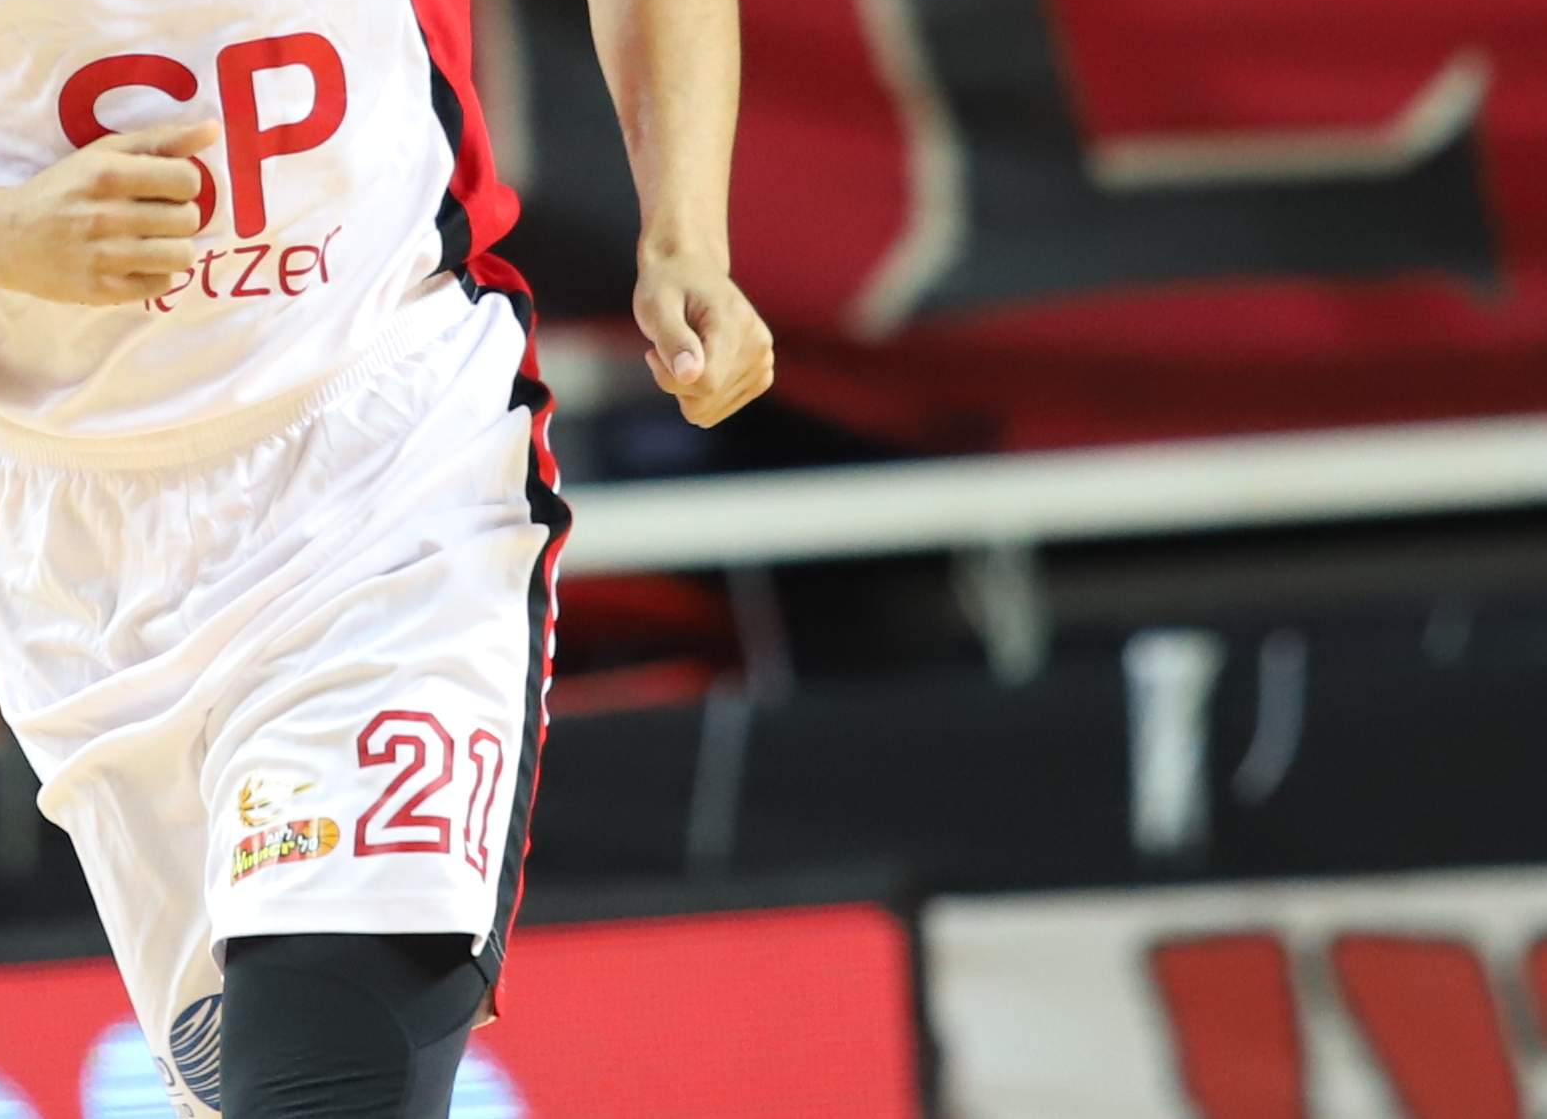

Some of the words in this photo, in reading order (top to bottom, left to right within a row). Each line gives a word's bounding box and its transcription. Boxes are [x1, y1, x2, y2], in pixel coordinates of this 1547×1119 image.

[58, 32, 347, 239] SP
[144, 225, 342, 312] etzer
[354, 710, 504, 884] 21
